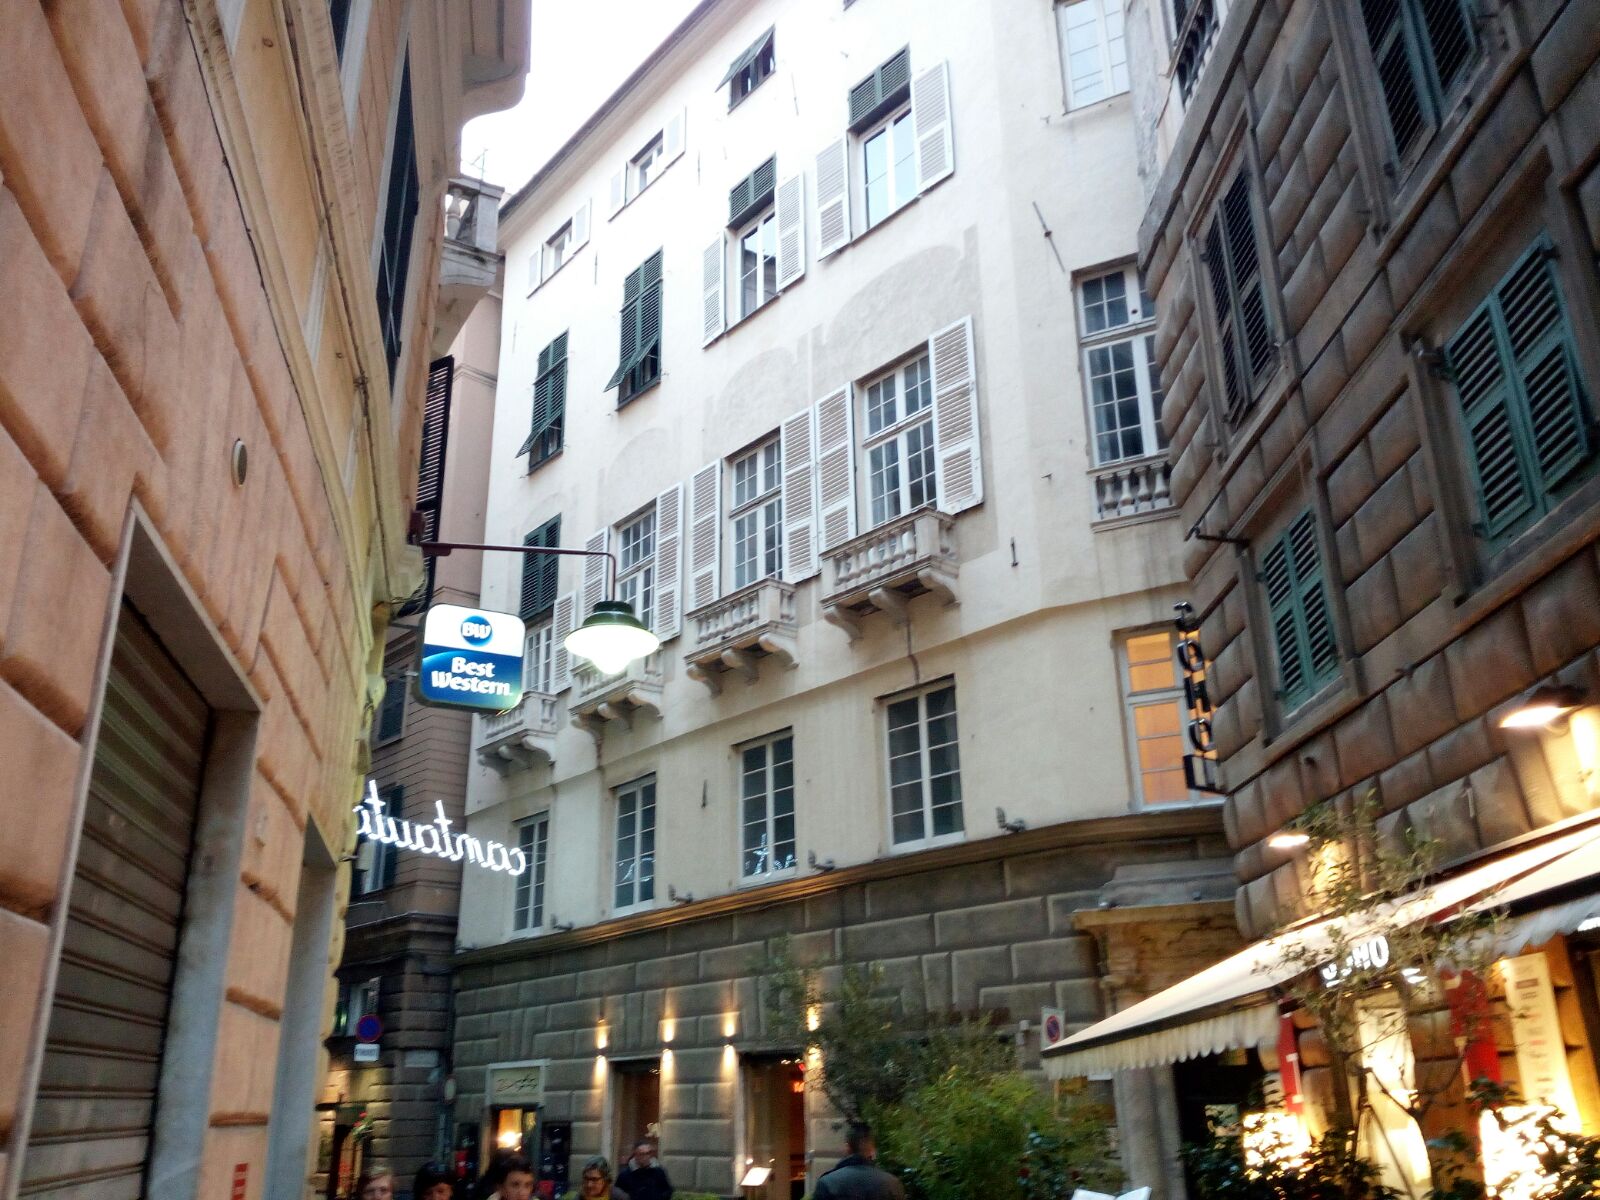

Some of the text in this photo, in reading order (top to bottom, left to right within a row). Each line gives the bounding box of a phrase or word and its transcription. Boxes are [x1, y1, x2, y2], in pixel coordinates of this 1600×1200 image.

[461, 621, 492, 640] BW
[450, 656, 496, 678] Best
[431, 670, 511, 696] Western
